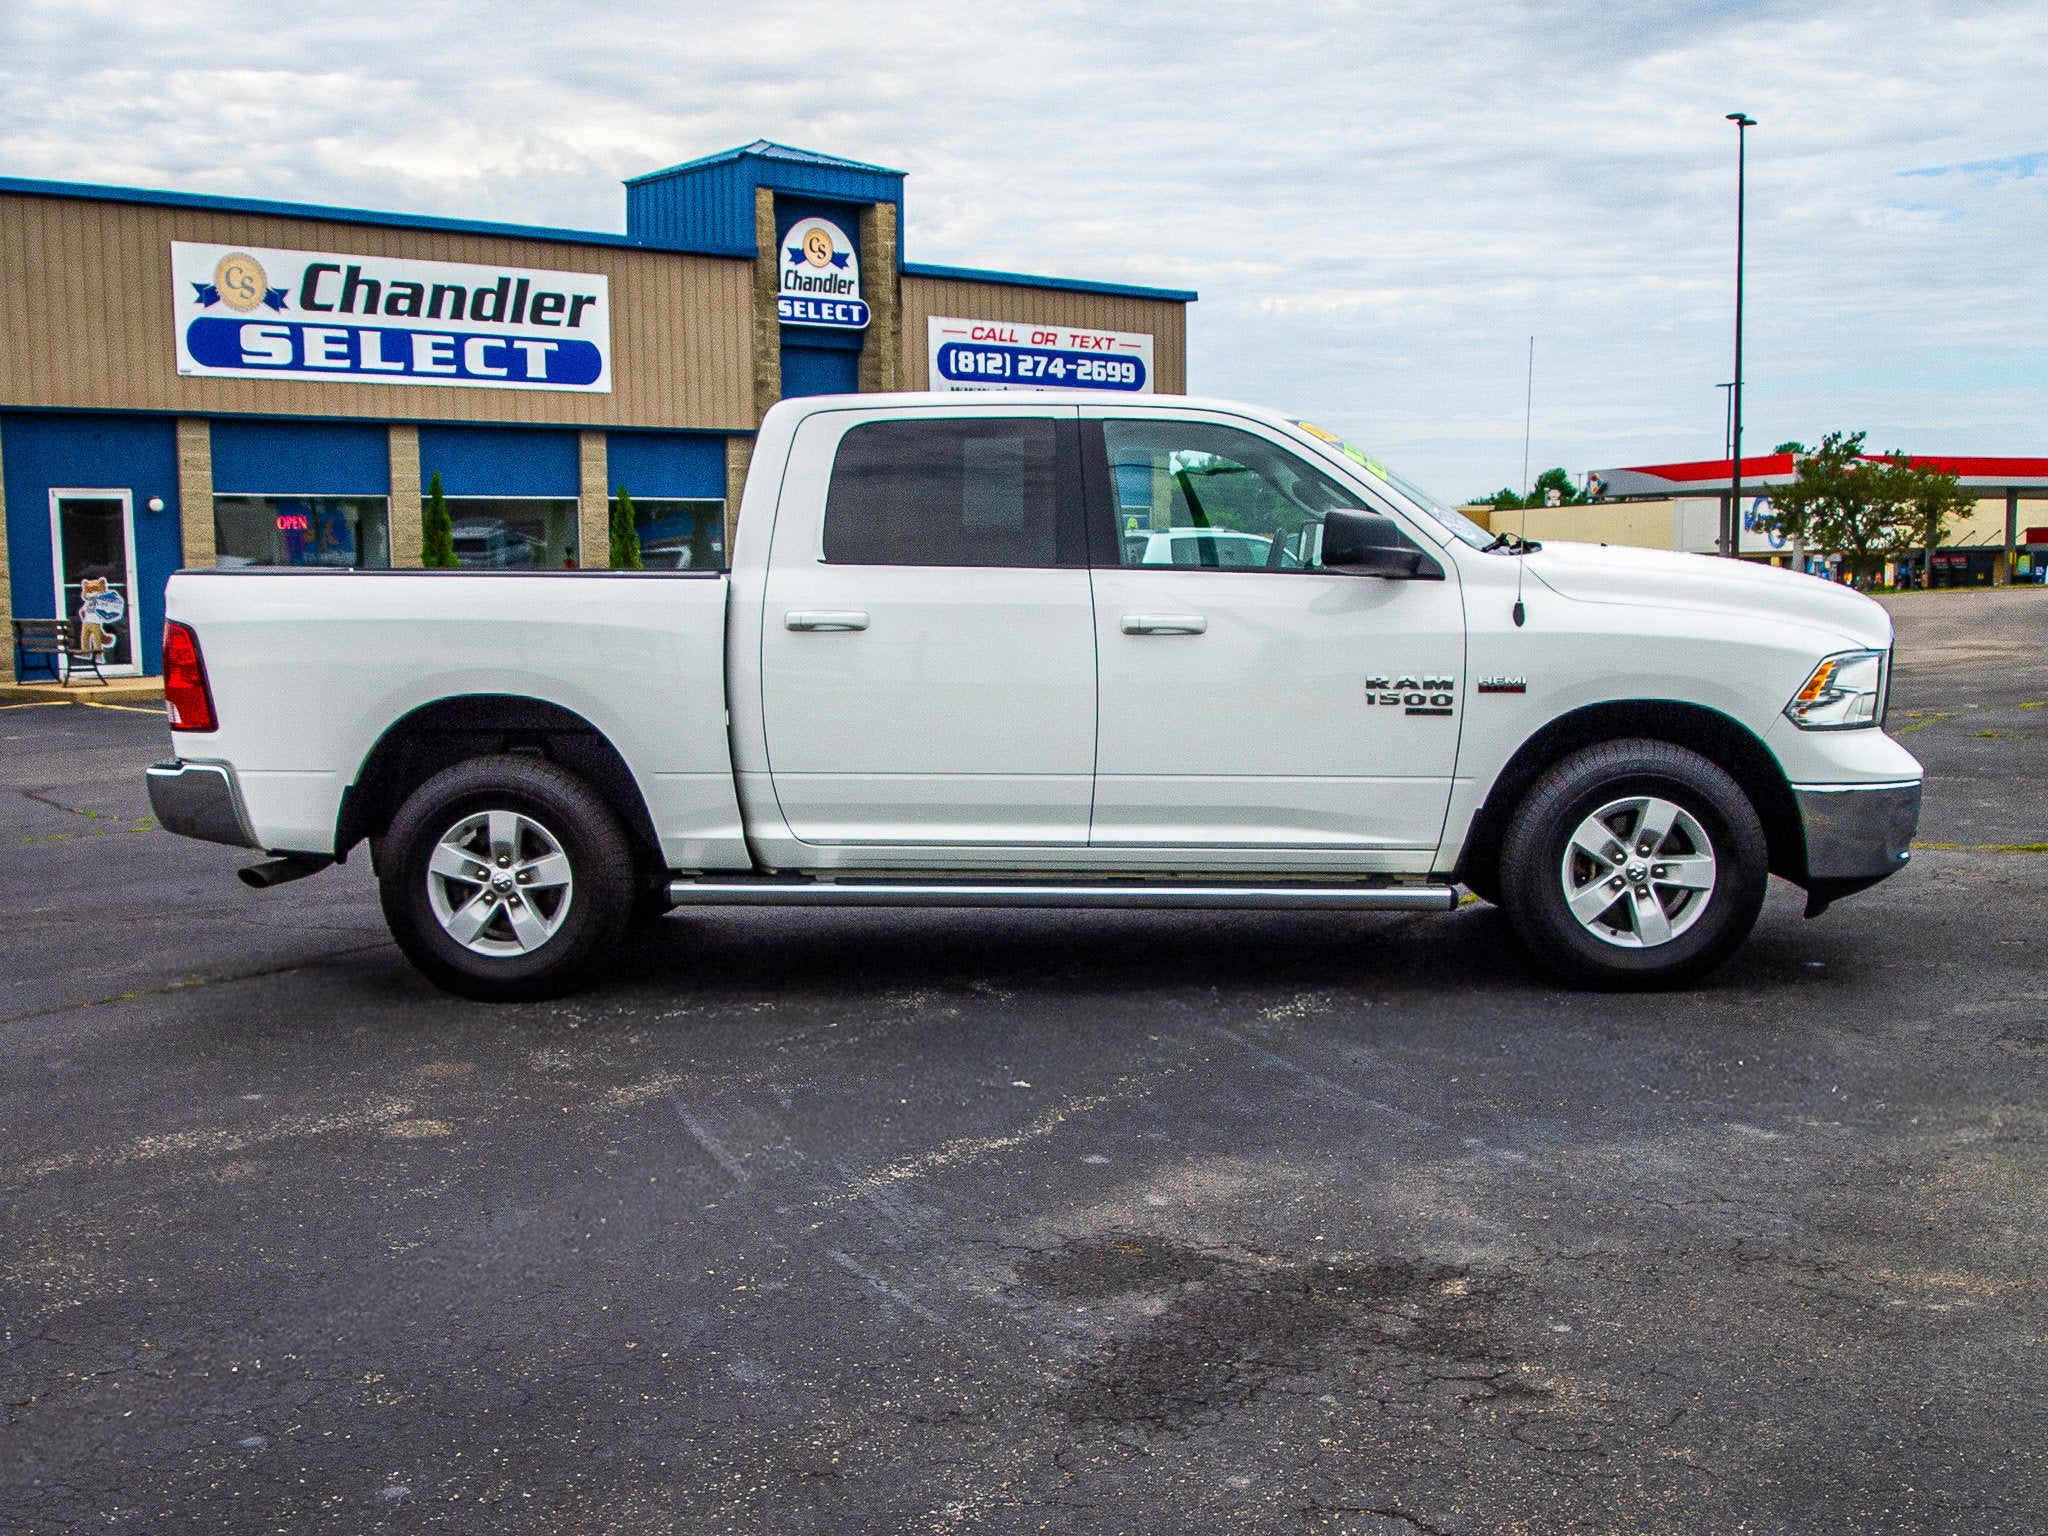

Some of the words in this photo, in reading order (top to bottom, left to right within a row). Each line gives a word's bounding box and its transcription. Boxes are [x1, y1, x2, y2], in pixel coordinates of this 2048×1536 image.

[784, 269, 855, 295] Chandler
[300, 262, 597, 328] Chandler
[778, 299, 863, 322] SELECT
[971, 326, 1018, 343] CALL
[1031, 331, 1057, 346] OR
[1070, 334, 1116, 350] TEXT
[239, 323, 559, 379] SELECT
[950, 349, 1011, 377] (812)
[1017, 354, 1136, 384] 274-2699
[276, 515, 308, 530] OPEN
[1365, 675, 1454, 690] RAM
[1478, 676, 1526, 686] HEMI
[1365, 691, 1454, 706] 1500
